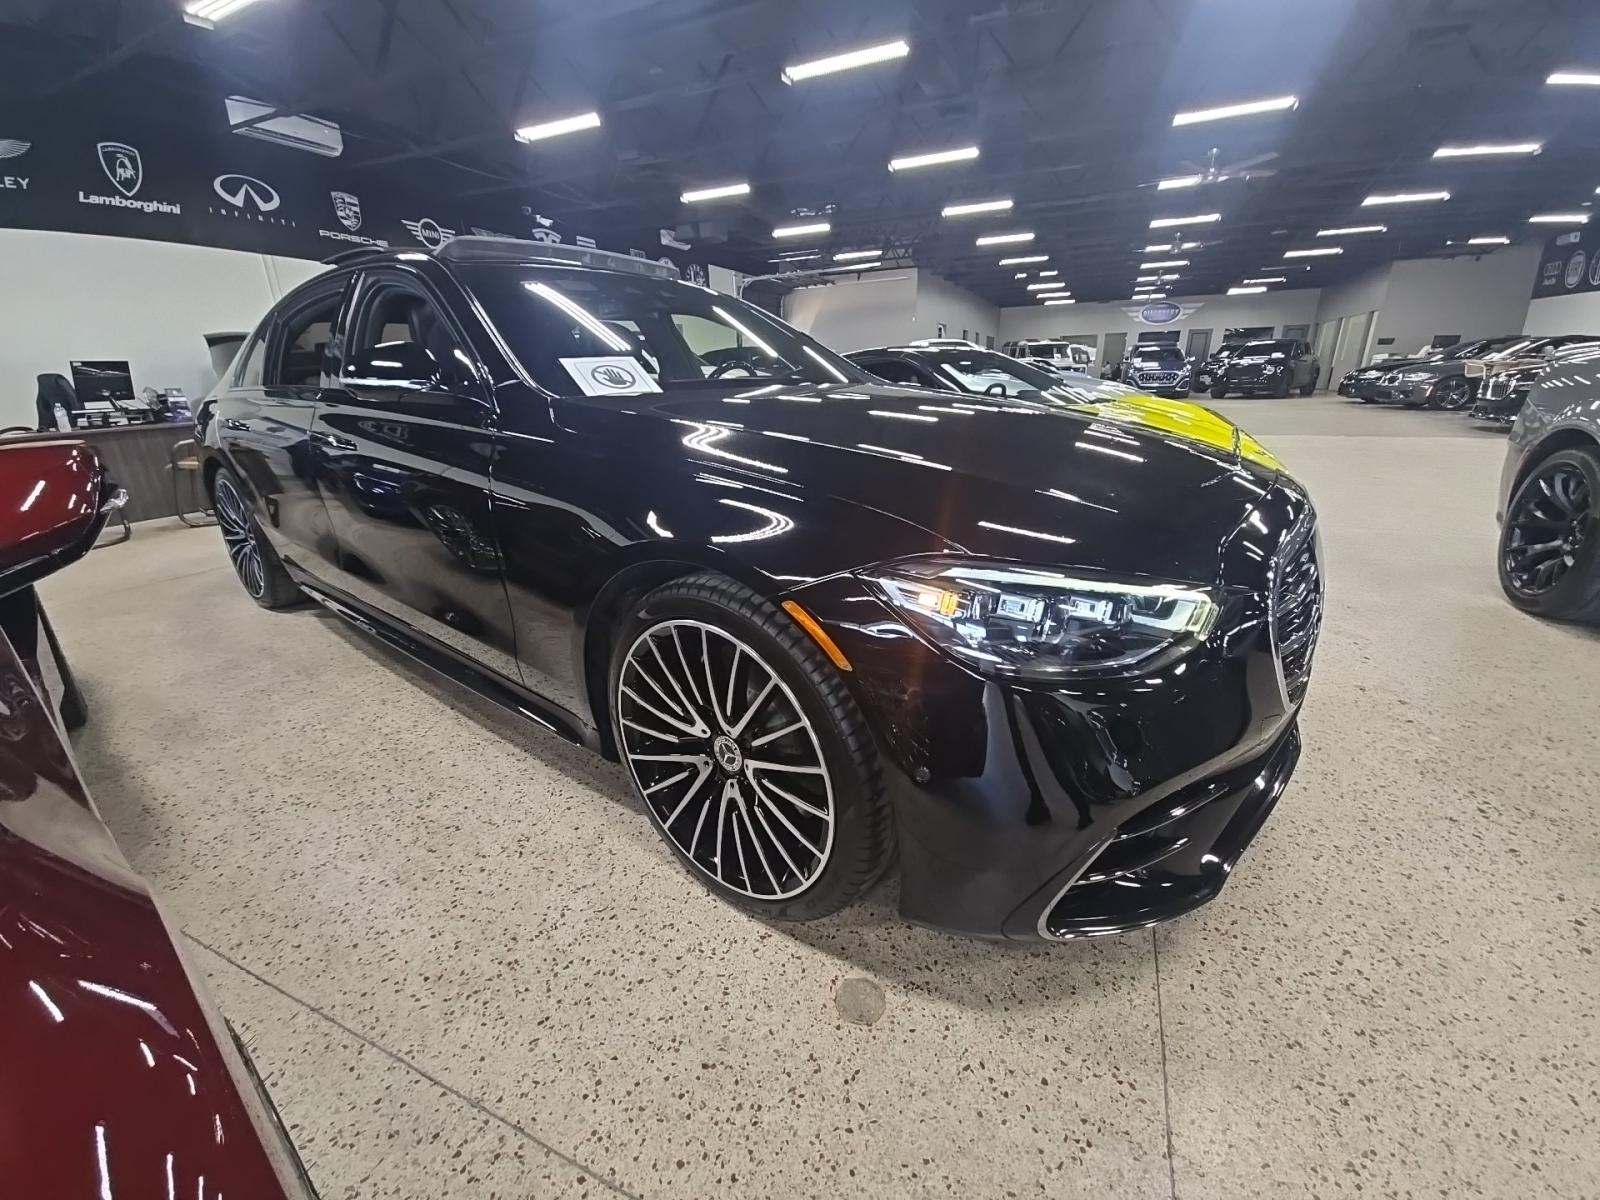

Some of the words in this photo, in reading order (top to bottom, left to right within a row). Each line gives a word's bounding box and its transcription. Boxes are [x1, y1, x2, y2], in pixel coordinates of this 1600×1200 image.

[79, 191, 181, 214] Lamborghini
[319, 230, 389, 247] PORSCHE
[421, 228, 440, 240] MINI
